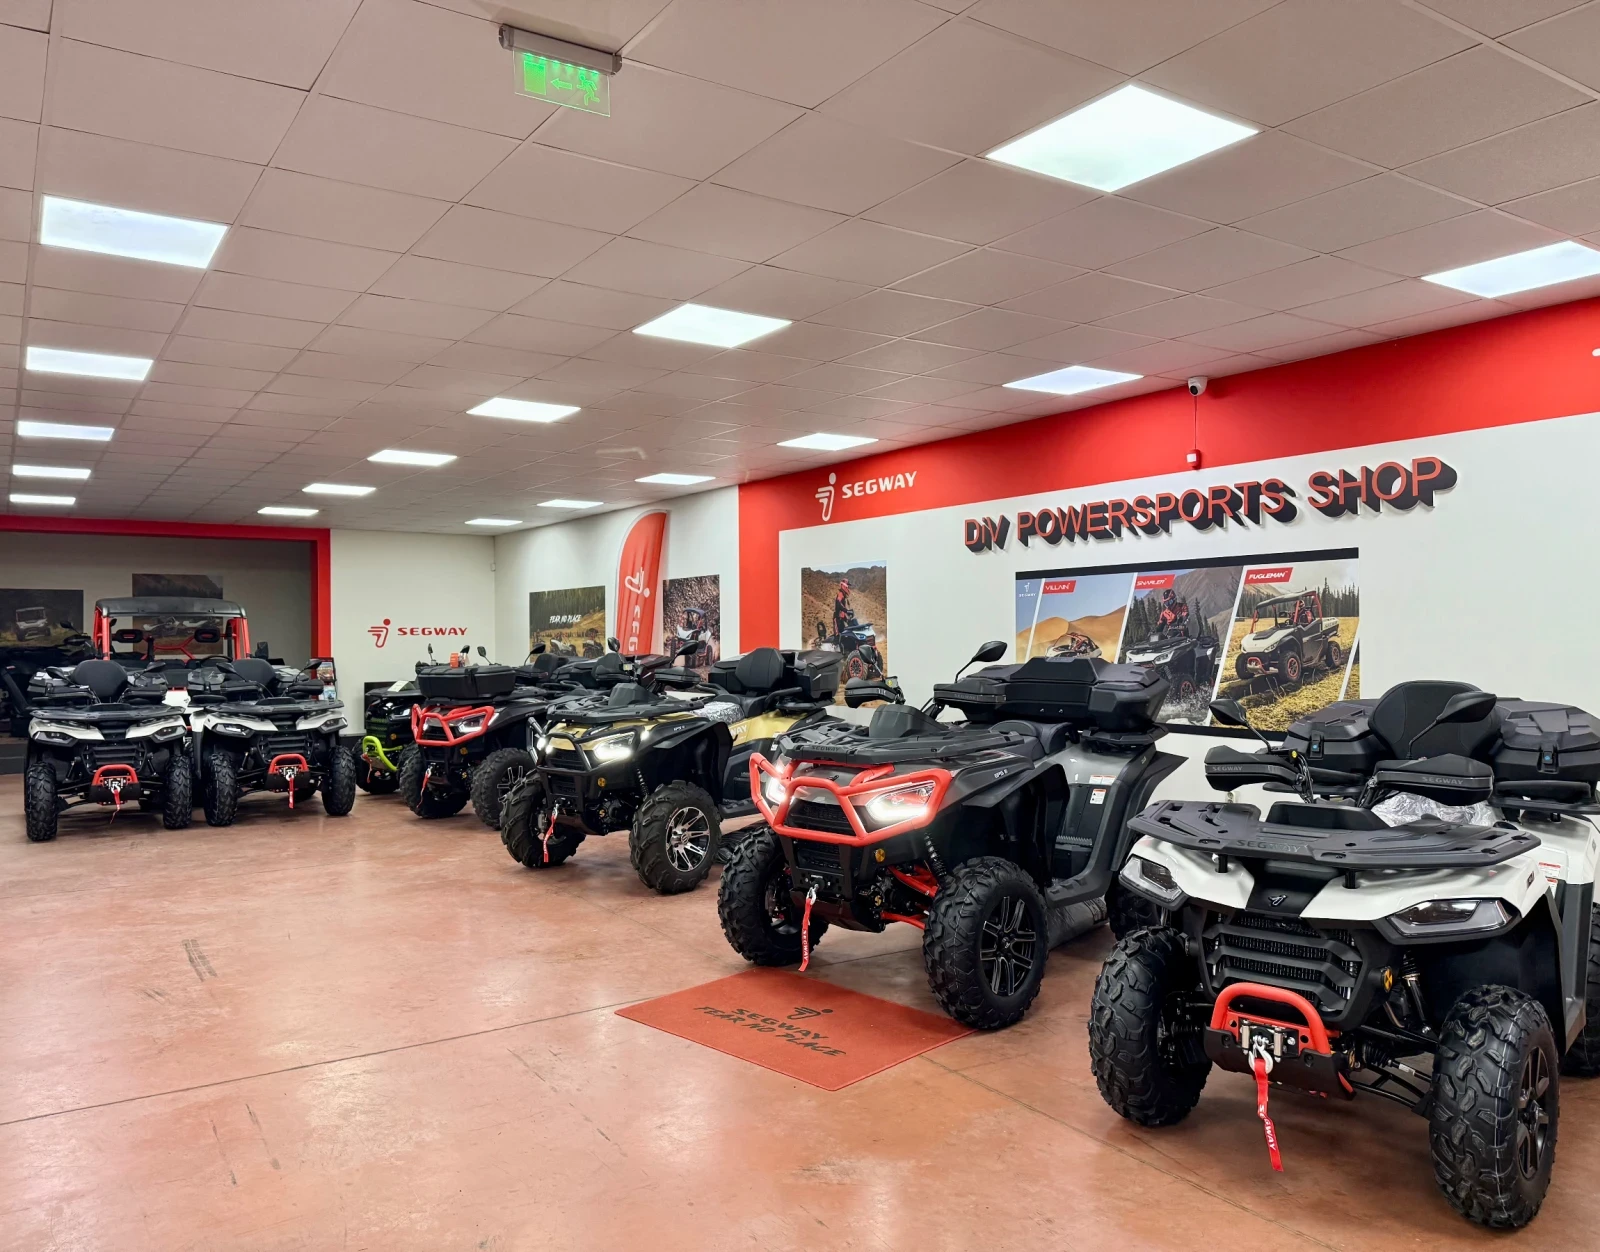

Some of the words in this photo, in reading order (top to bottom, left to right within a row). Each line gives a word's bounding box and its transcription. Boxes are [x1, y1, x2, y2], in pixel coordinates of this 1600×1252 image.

[842, 471, 917, 498] SEGWAY
[1017, 478, 1290, 544] POWERSPORTS
[1307, 456, 1451, 513] SHOP
[1045, 583, 1069, 591] VILLAIN
[397, 627, 467, 636] SEGWAY
[1422, 776, 1464, 785] SEGWAY
[1236, 840, 1300, 852] SEGWAY
[693, 1006, 746, 1024] FEAR
[741, 1023, 776, 1033] NO
[775, 1033, 847, 1056] PLACE
[731, 1008, 829, 1040] SEGWAY
